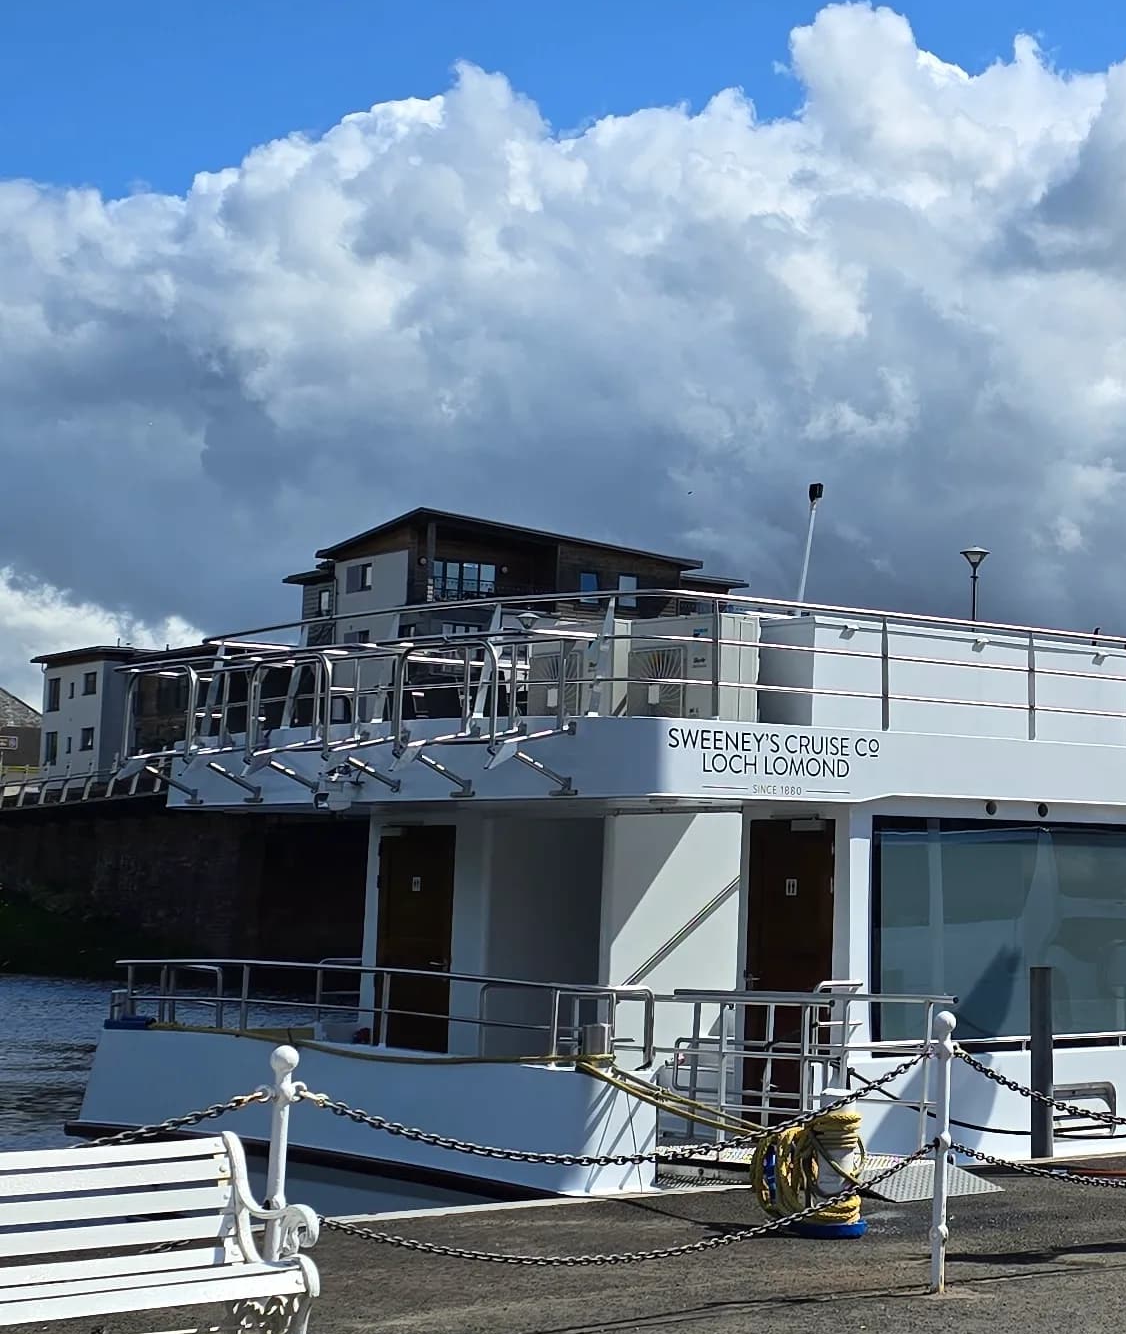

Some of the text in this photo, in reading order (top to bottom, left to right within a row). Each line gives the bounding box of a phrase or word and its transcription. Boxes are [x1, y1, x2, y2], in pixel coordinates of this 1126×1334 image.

[668, 727, 780, 753] SWEENEY'S
[784, 734, 850, 756] CRUISE
[702, 753, 850, 778] LOCH LOMOND
[752, 784, 802, 796] SINCE 1880
